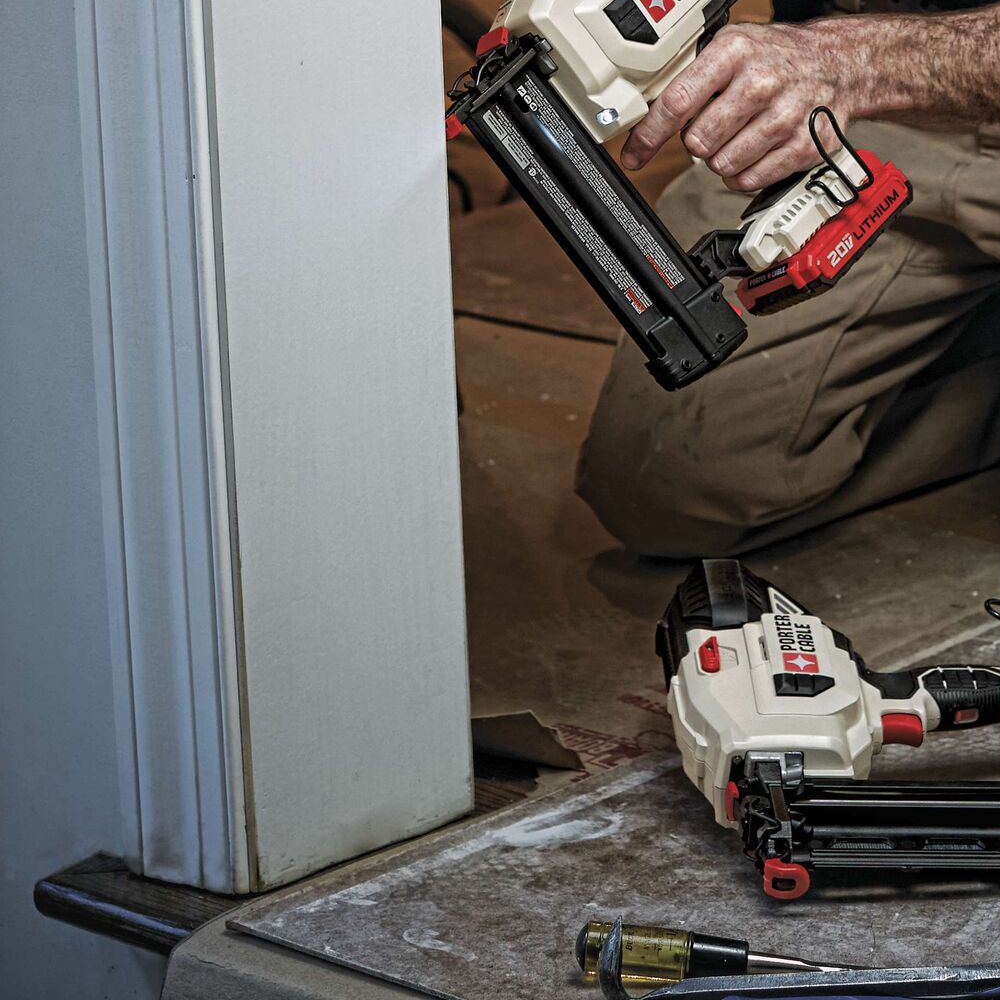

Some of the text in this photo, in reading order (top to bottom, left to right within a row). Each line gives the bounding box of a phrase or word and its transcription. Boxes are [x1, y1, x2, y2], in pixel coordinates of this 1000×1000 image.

[853, 189, 900, 241] LITHIUM
[771, 266, 786, 278] CABLE
[774, 614, 797, 651] PORTER
[794, 623, 816, 653] CABLE
